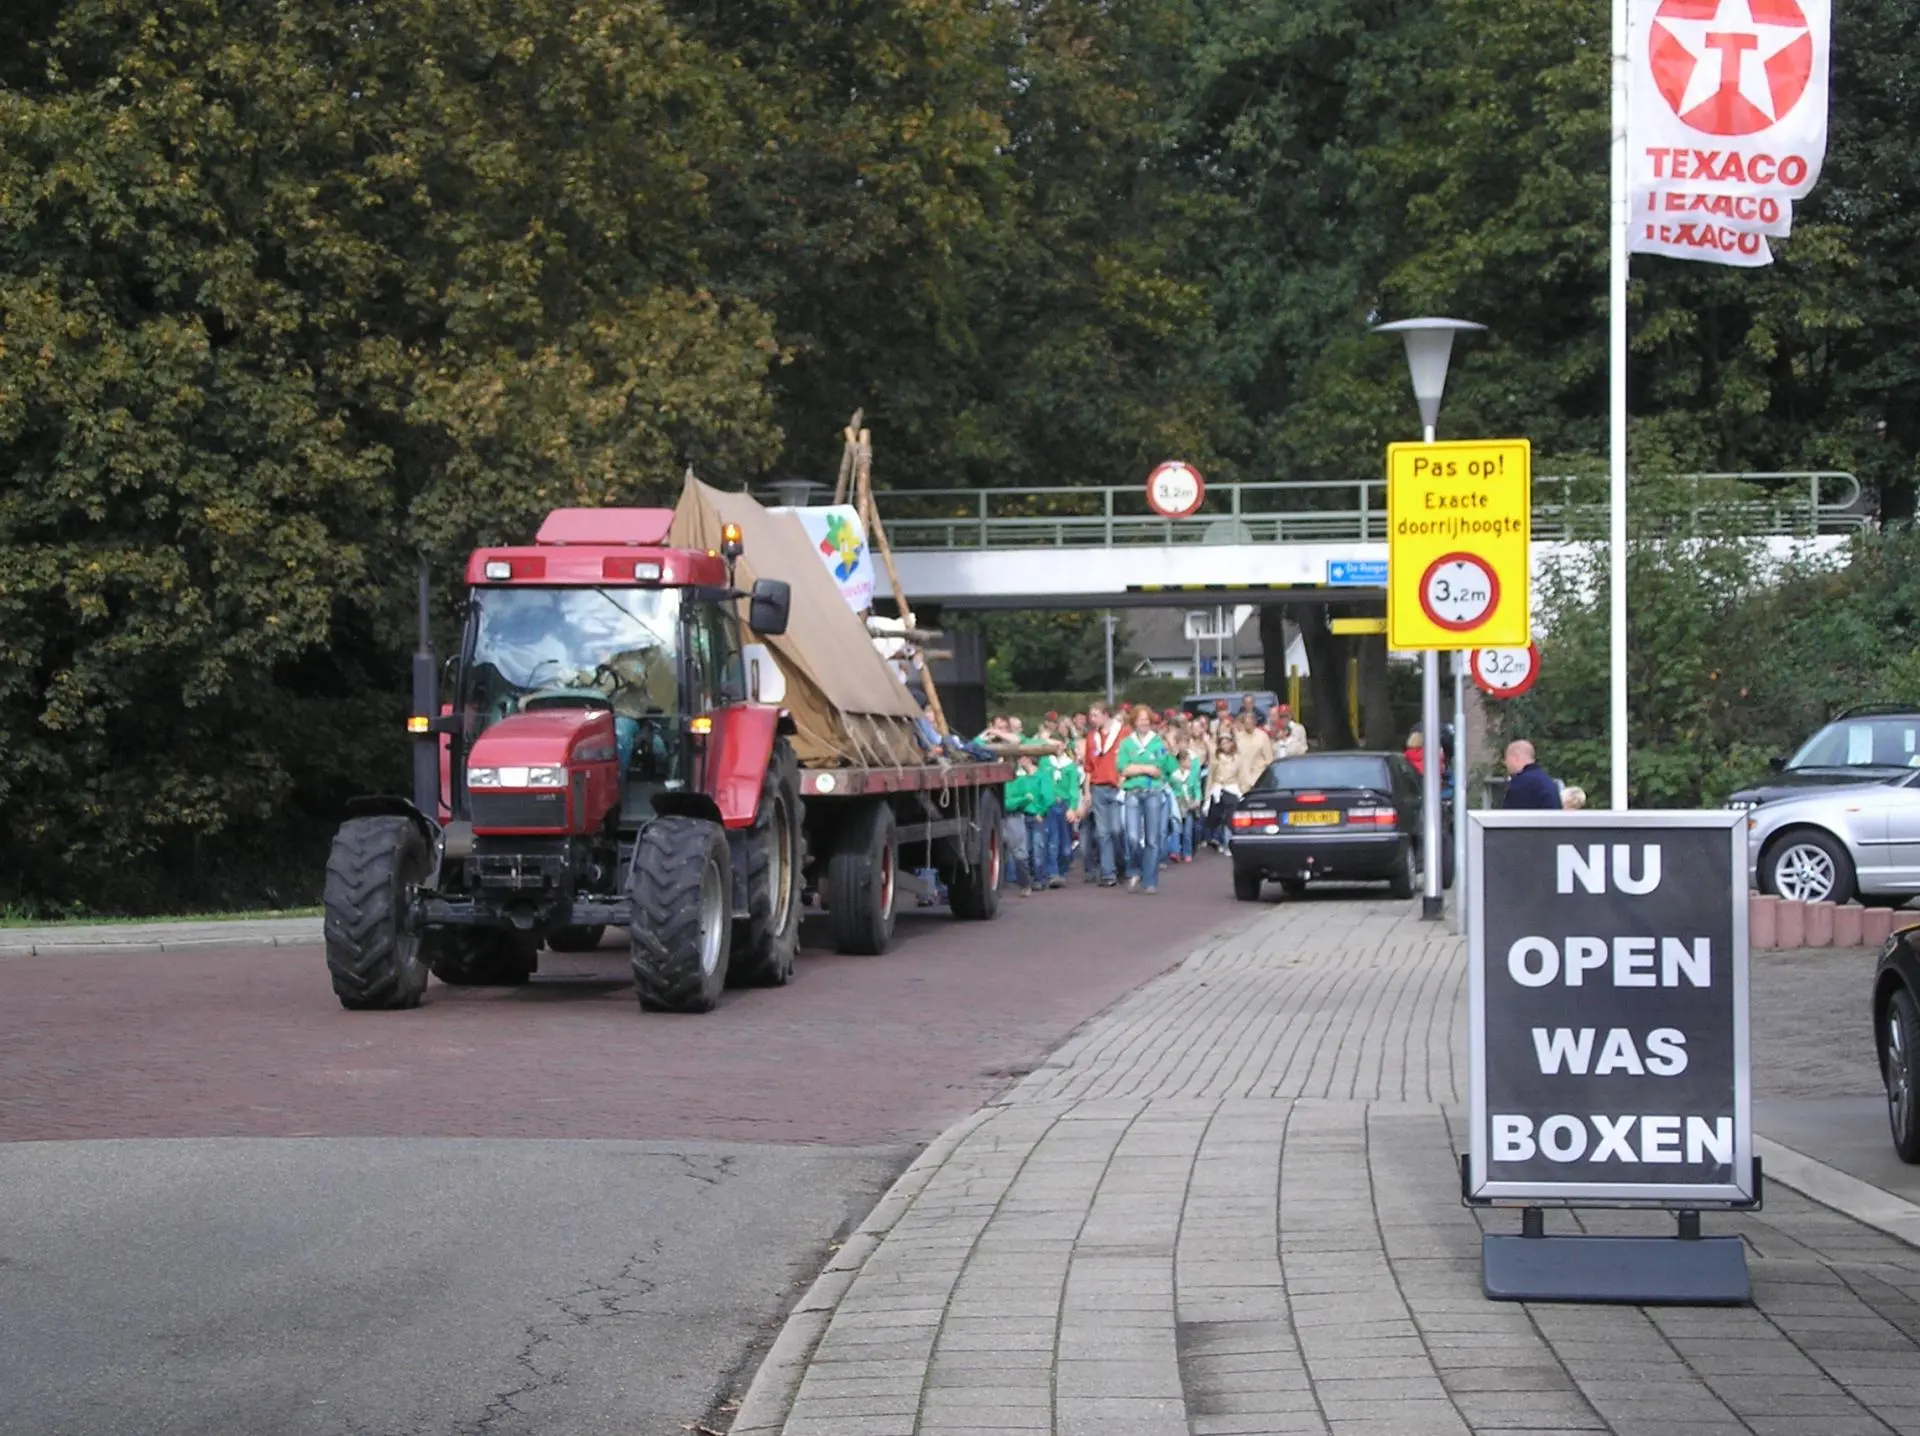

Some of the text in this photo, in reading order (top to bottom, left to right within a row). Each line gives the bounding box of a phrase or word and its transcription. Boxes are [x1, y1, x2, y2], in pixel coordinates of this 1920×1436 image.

[1646, 148, 1808, 186] TEXACO
[1413, 454, 1505, 478] Pas op!
[1425, 491, 1489, 509] Exacte
[1397, 516, 1522, 540] doorrijhoogte
[1556, 844, 1662, 895] NU
[1507, 936, 1712, 988] OPEN
[1531, 1028, 1689, 1076] WAS
[1491, 1114, 1733, 1164] BOXEN
